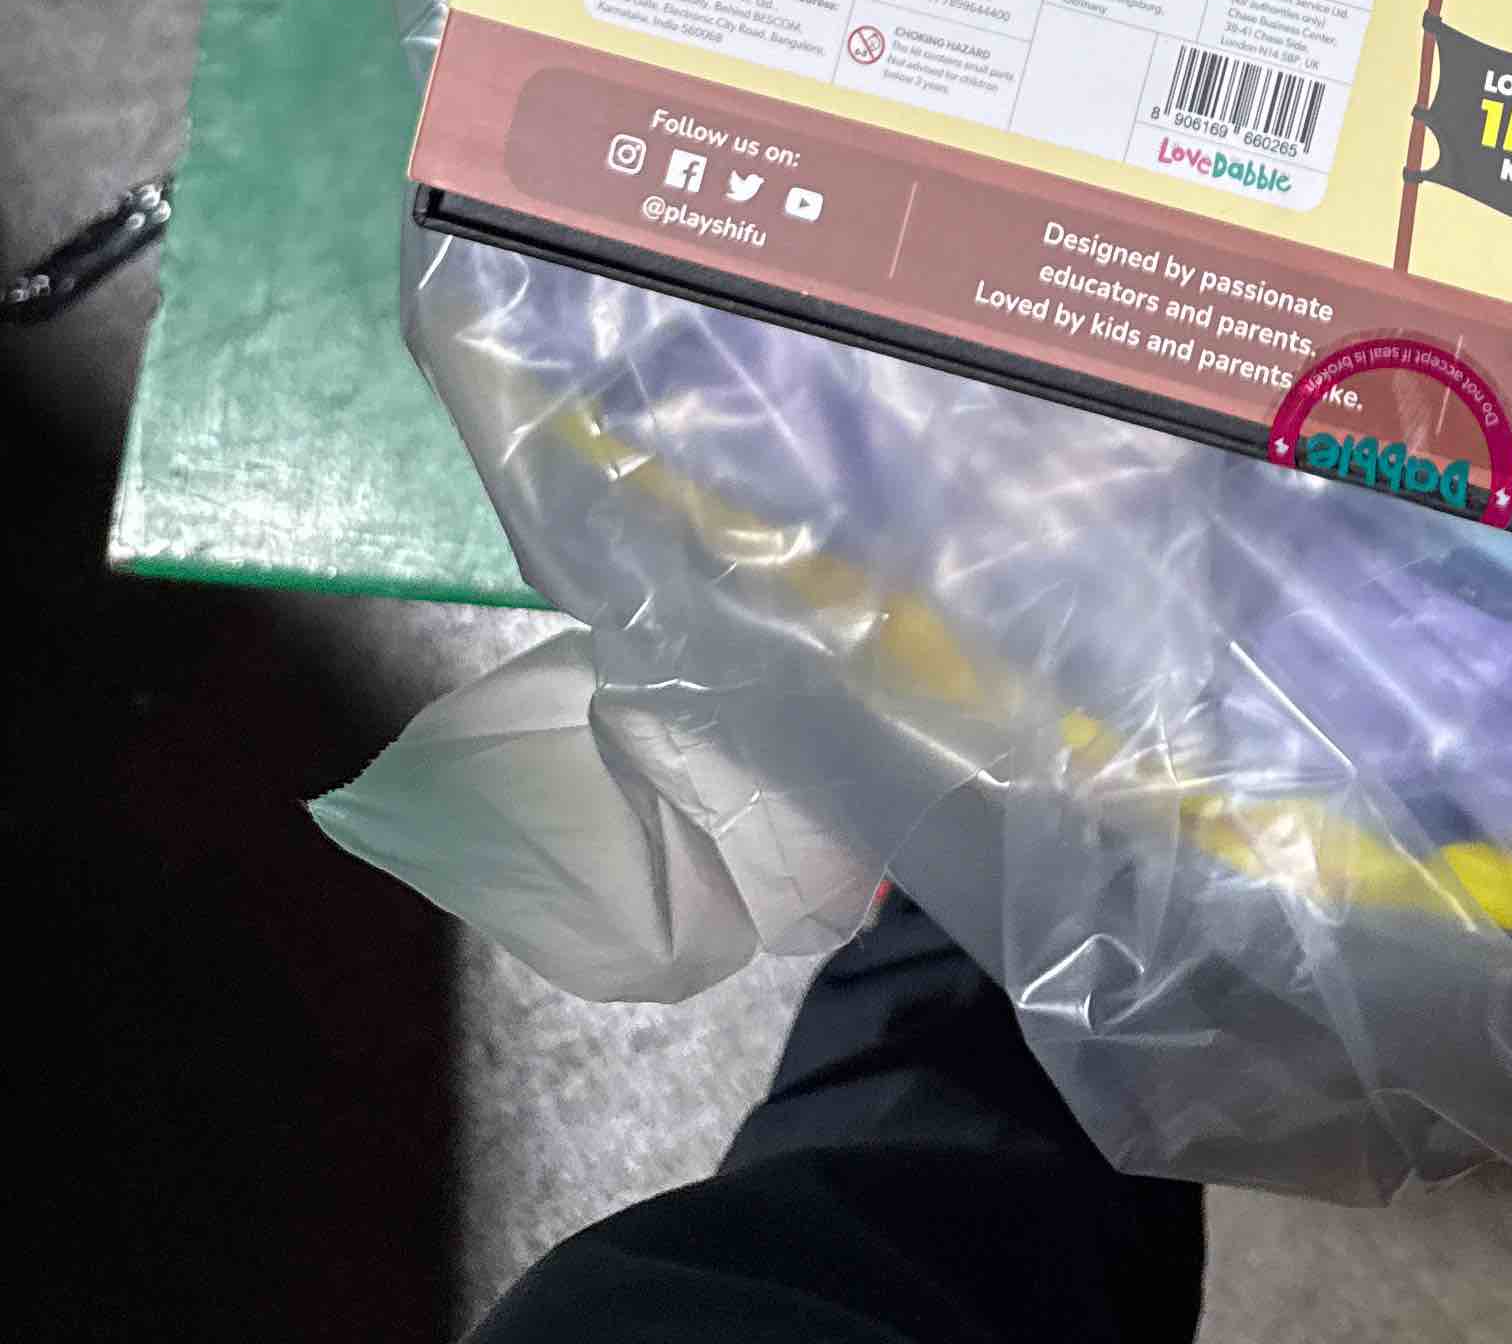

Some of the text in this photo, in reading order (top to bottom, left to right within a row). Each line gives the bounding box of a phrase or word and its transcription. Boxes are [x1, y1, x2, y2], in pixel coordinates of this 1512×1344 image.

[649, 107, 802, 169] Follow us on:
[1173, 111, 1230, 140] 906169
[1242, 130, 1299, 159] 660265
[1157, 137, 1290, 193] LoveDabble
[641, 194, 768, 248] @playshifu
[1042, 220, 1335, 324] Designed by passionate
[974, 278, 1294, 391] Loved by kids and parents
[1038, 264, 1317, 358] educators and parents.
[1305, 432, 1473, 508] Dabble
